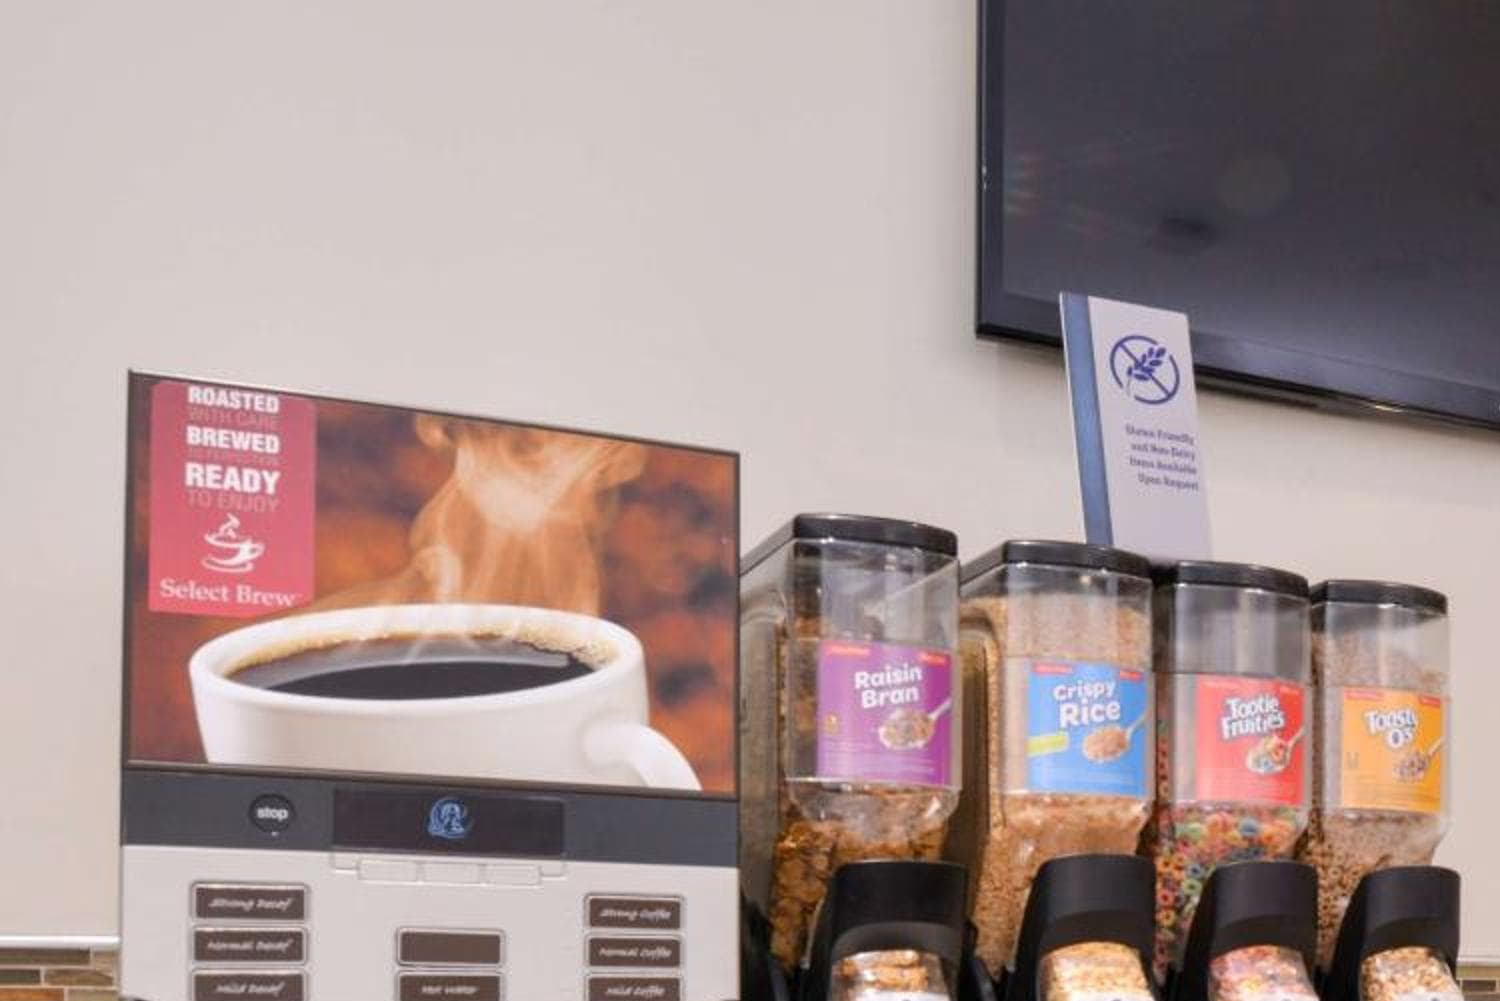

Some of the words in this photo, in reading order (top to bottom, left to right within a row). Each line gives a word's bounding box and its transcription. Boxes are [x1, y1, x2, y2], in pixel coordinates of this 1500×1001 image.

[188, 385, 280, 414] ROASTED
[186, 426, 280, 454] BREWED
[185, 462, 281, 495] READY
[159, 577, 230, 603] Select
[236, 584, 296, 608] Brew
[854, 662, 923, 690] Raisin
[861, 686, 920, 710] Bran
[1059, 697, 1122, 730] Rice
[257, 805, 289, 822] stop
